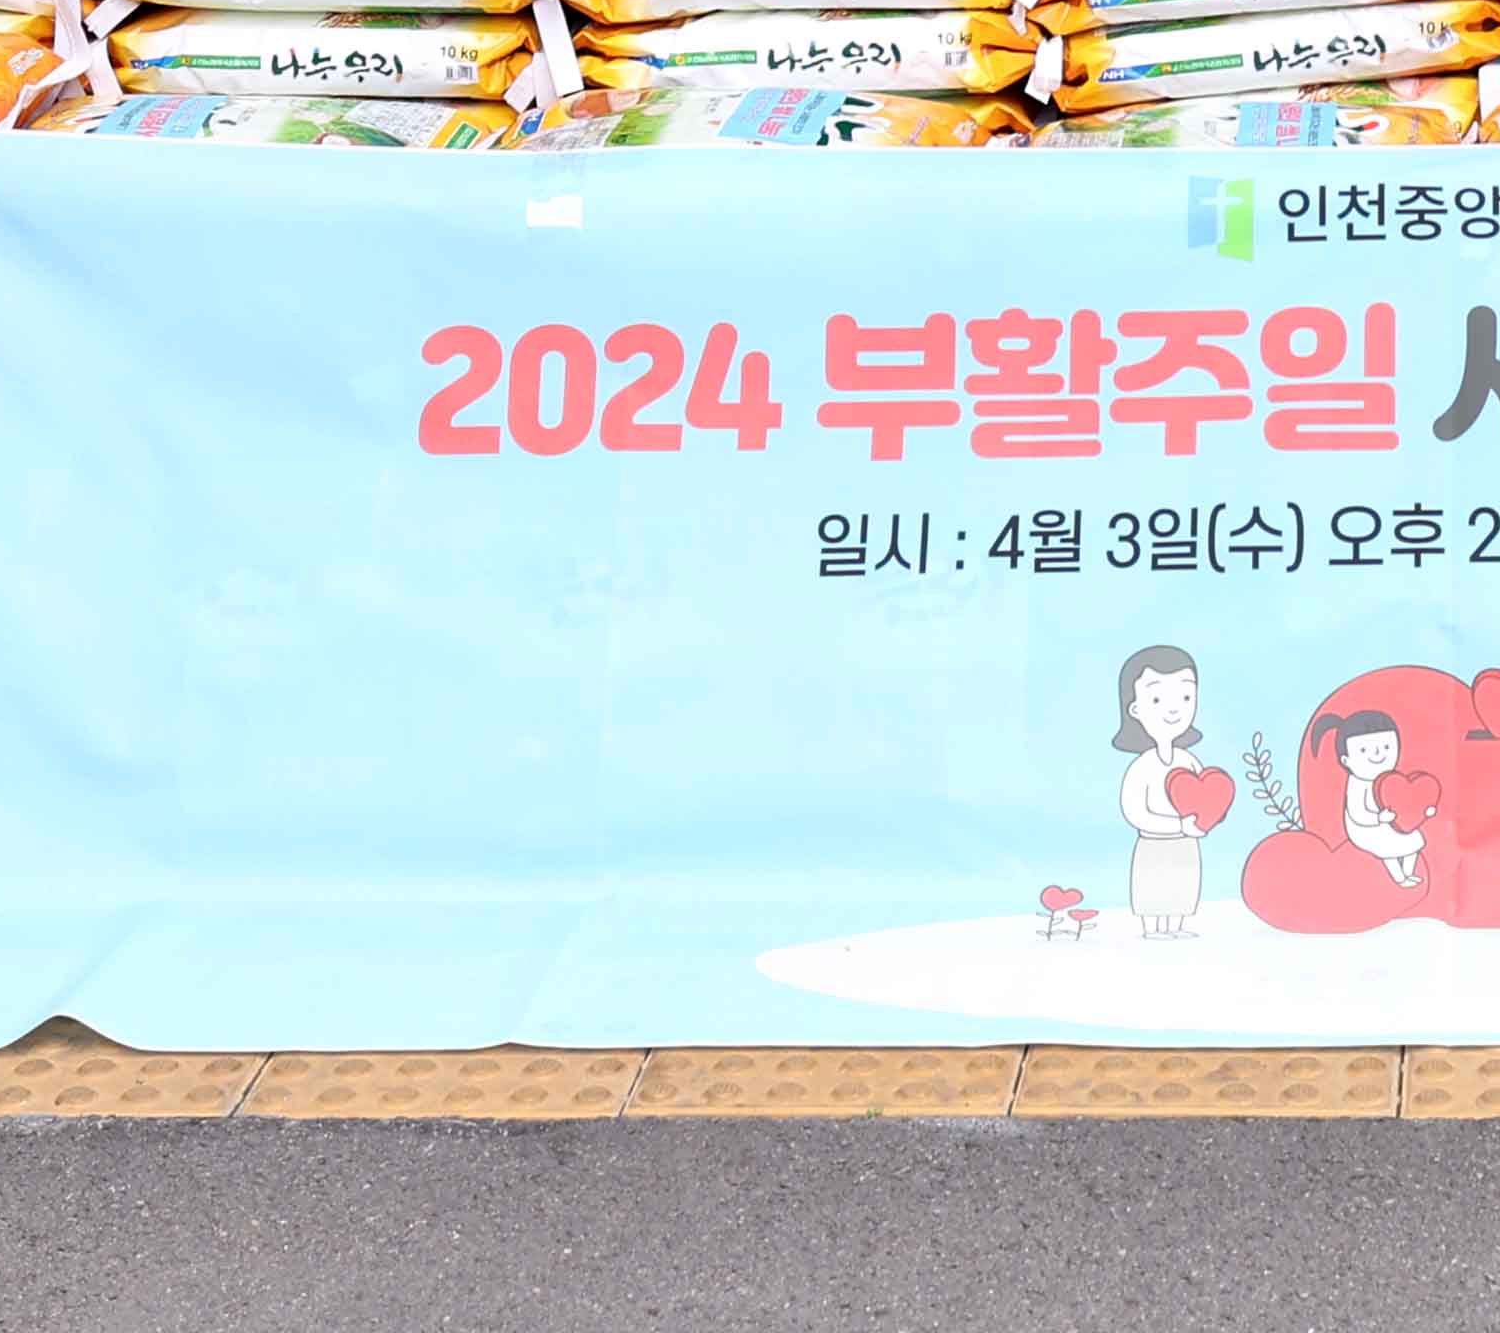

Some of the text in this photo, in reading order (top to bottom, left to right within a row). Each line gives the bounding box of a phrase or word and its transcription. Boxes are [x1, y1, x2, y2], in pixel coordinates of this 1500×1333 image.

[418, 323, 784, 456] 2024
[817, 302, 1400, 461] 부활주일
[817, 513, 930, 577] 일시
[987, 510, 1083, 573] 4월
[1106, 502, 1305, 573] 3일(수)
[1328, 503, 1446, 568] 오후
